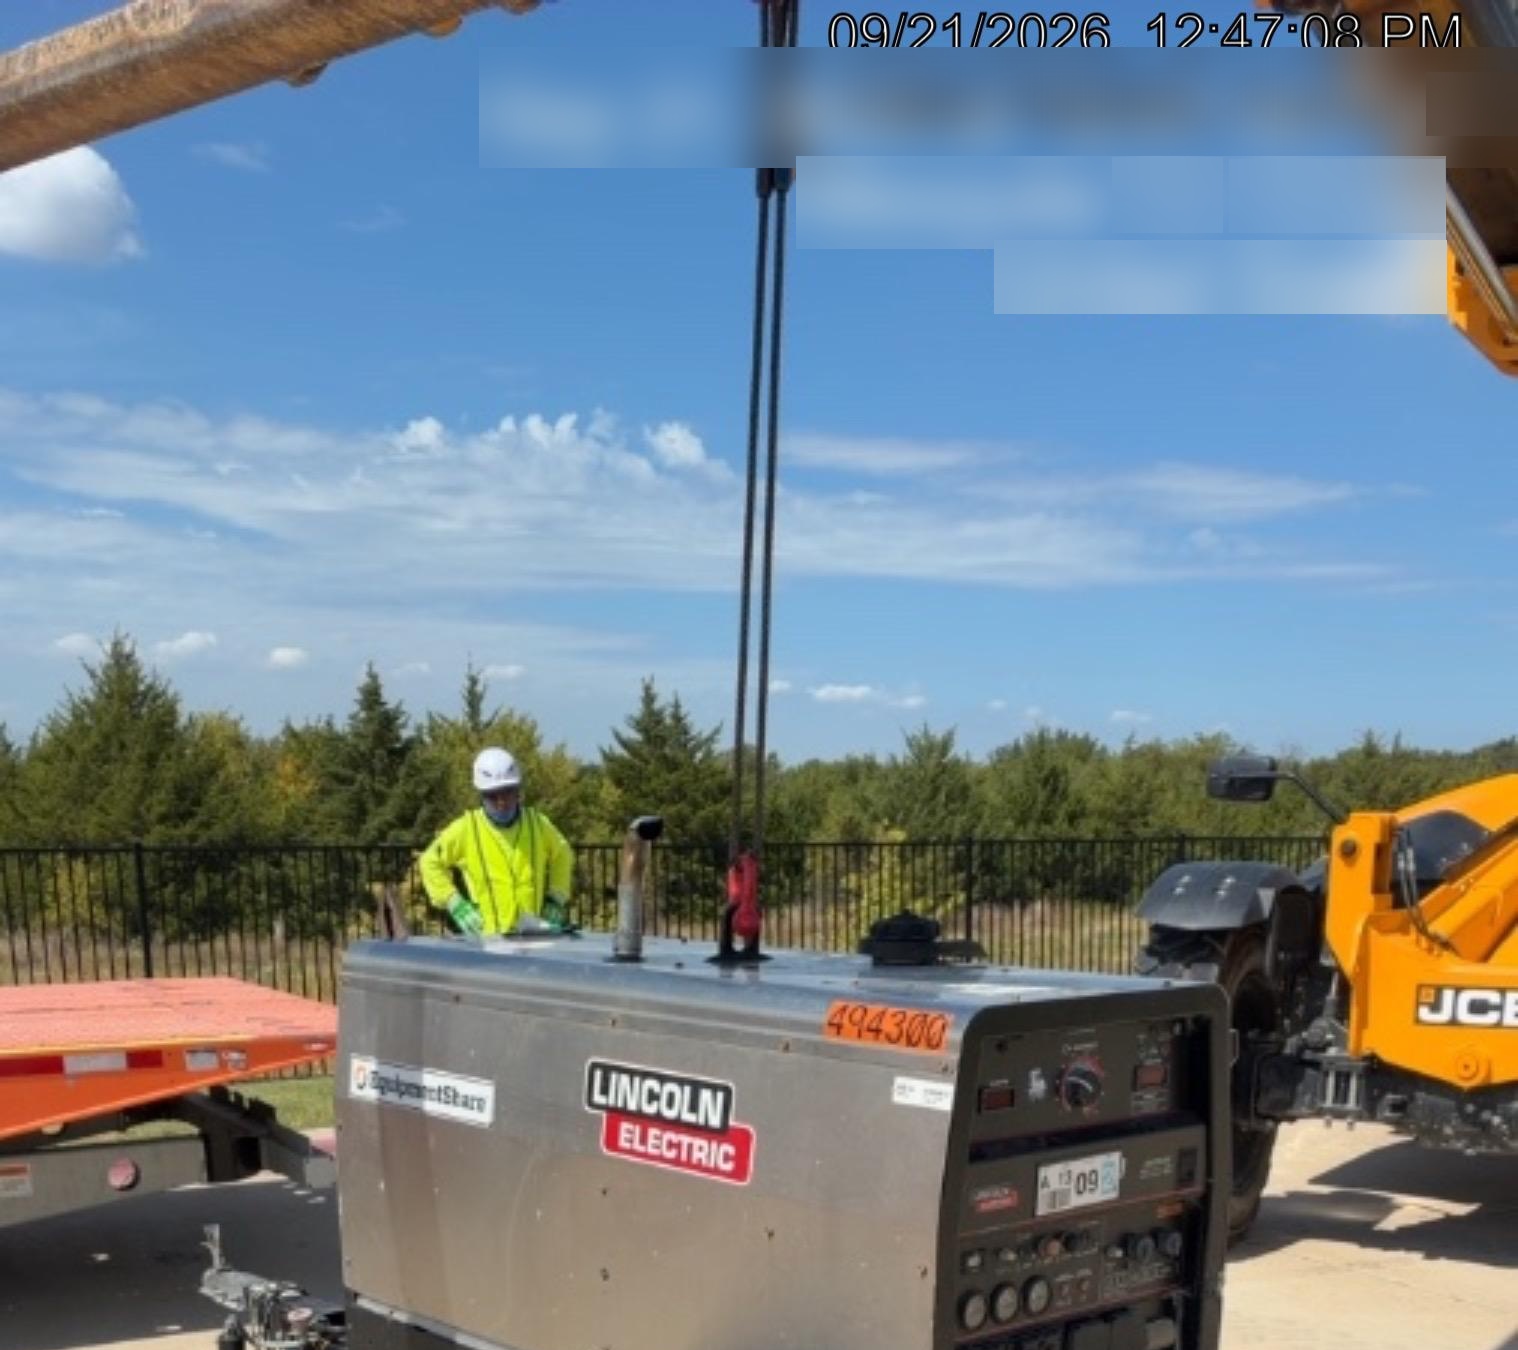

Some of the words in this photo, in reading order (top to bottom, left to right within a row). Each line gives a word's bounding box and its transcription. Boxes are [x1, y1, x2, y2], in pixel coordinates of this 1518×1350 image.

[828, 1004, 948, 1050] 494300
[593, 1067, 725, 1129] LINCOLN
[617, 1121, 736, 1171] ELECTRIC
